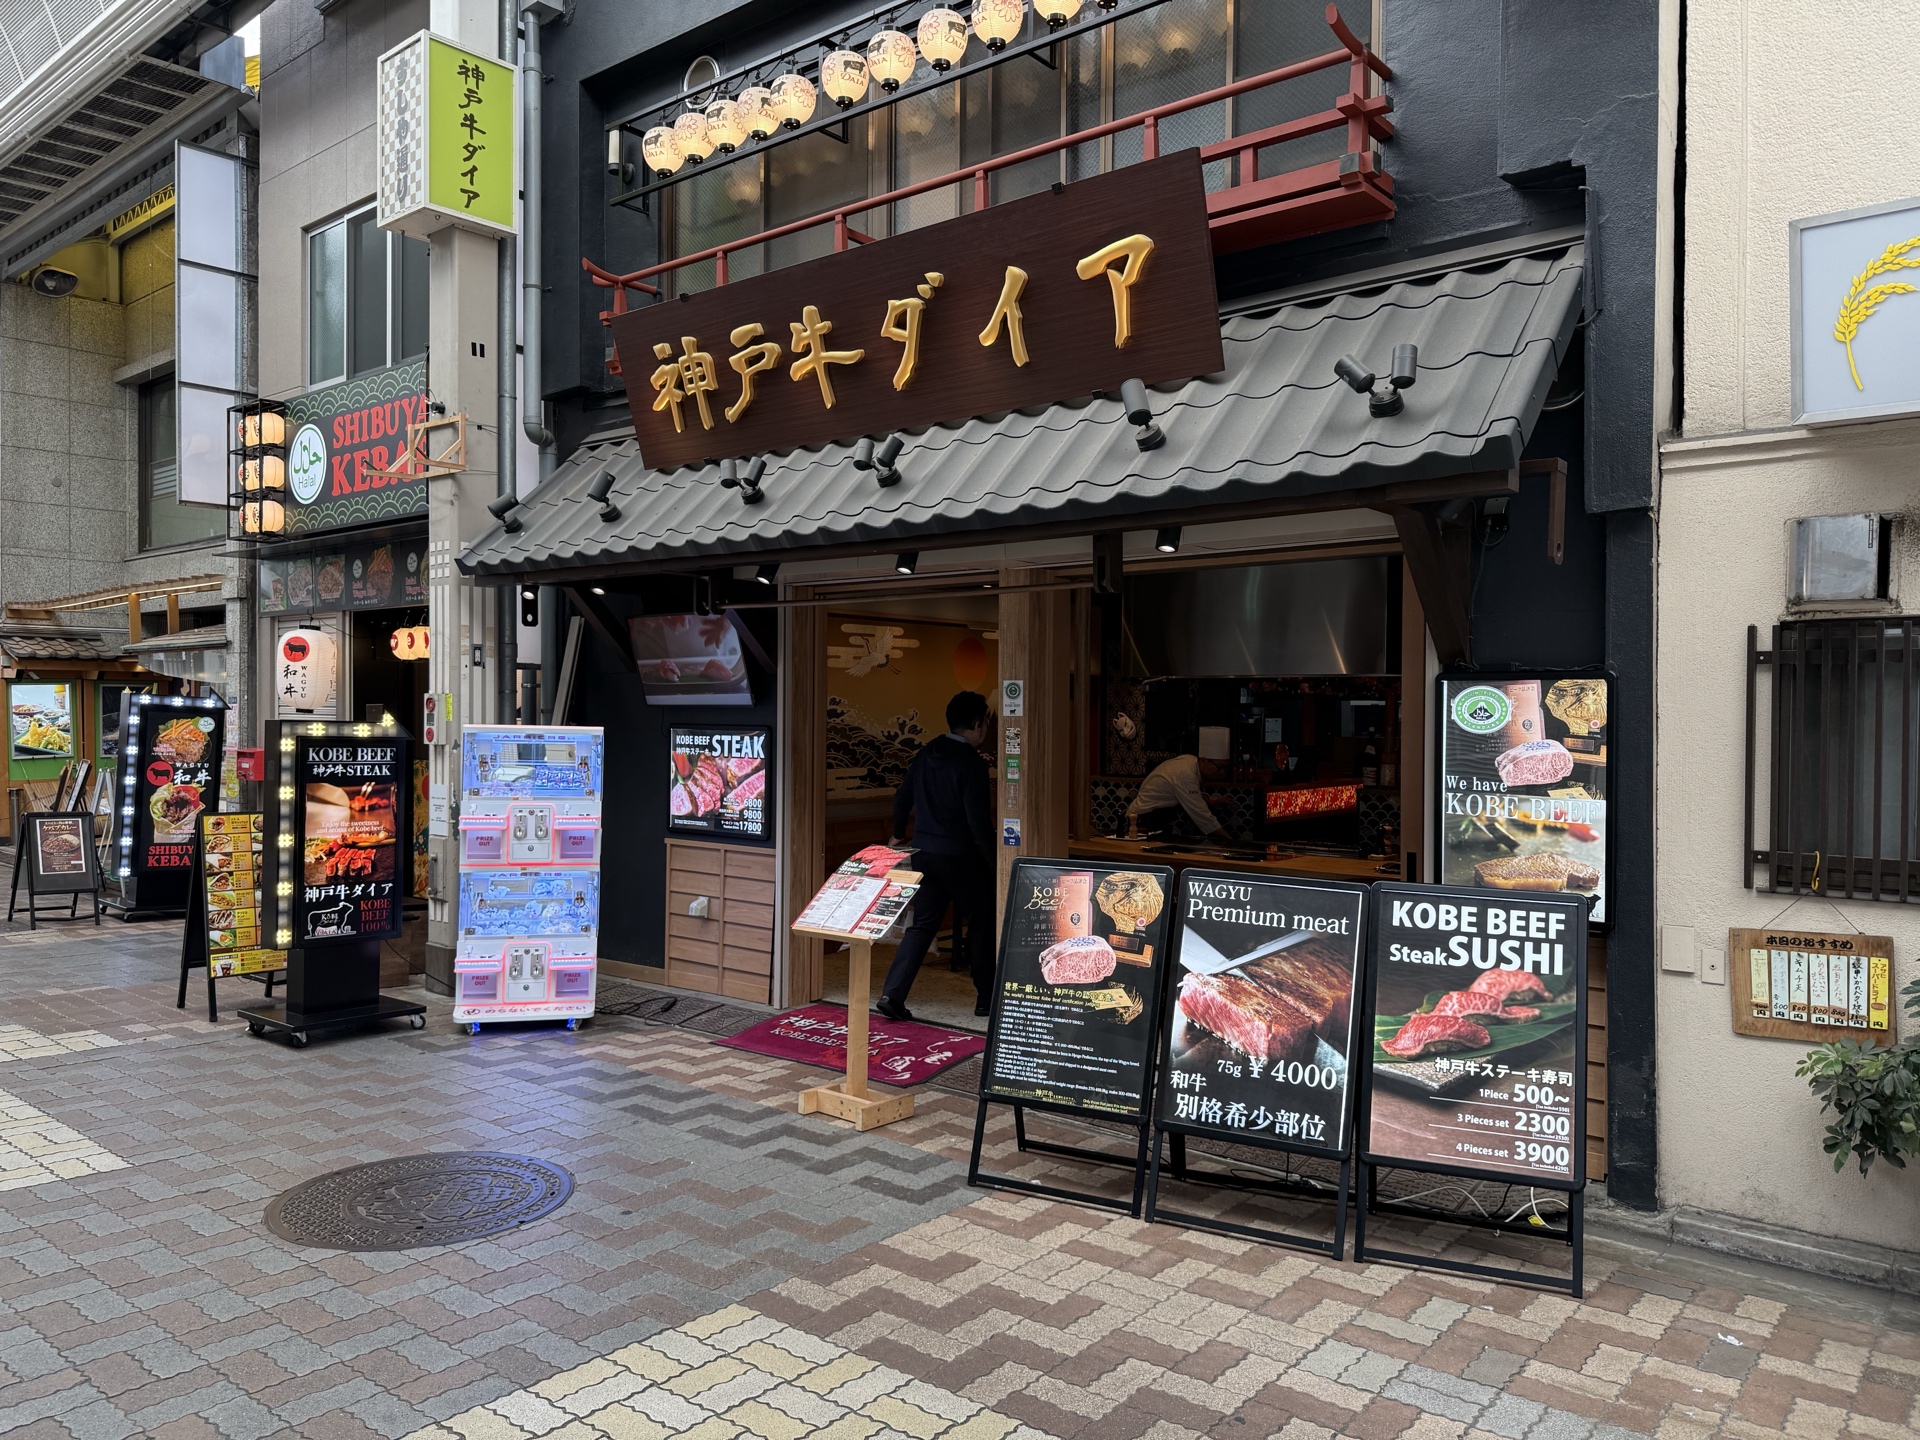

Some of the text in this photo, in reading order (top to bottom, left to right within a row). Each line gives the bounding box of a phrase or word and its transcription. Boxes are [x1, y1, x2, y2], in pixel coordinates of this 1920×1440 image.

[840, 72, 864, 87] DAIA
[457, 59, 486, 208] 神戸牛ダイア
[650, 233, 1155, 434] 神戸牛ダイア
[331, 437, 427, 496] KEBA
[298, 475, 316, 490] Halal
[284, 664, 298, 698] 和牛
[1464, 721, 1499, 729] STANDARD
[308, 747, 396, 761] KOBE BEEF
[676, 734, 766, 758] KOBE BEEF STEAK
[173, 769, 212, 786] 和牛
[313, 764, 391, 777] 神戸牛 STEAK
[1446, 775, 1508, 793] We have
[744, 799, 762, 807] 6800
[1446, 792, 1600, 825] KOBE BEEF
[743, 810, 762, 819] 9800
[740, 821, 762, 831] 17800
[149, 845, 194, 855] SHIBUY
[147, 855, 191, 867] KEBA
[304, 883, 393, 903] 神戸牛ダイア
[1033, 886, 1069, 898] KOBE
[1188, 882, 1252, 901] WAGYU
[360, 899, 391, 910] KOBE
[1024, 893, 1072, 910] Beef
[361, 910, 389, 921] BEEF
[1187, 899, 1349, 935] Premium meat
[1392, 900, 1566, 939] KOBE BEEF
[361, 921, 390, 933] 100%
[1766, 935, 1853, 949] 本日のおすすめ
[1389, 935, 1564, 975] Steak SUSHI
[1794, 958, 1804, 992] キムチ天
[770, 1028, 810, 1040] KOBE
[808, 1034, 842, 1047] BEEF
[1217, 1056, 1337, 1090] 75g ¥ 4000
[1434, 1057, 1572, 1086] 神戸牛ステーキ寿司
[1170, 1070, 1207, 1092] 和牛
[1479, 1088, 1509, 1100] 1Piece
[1174, 1093, 1326, 1141] 別格希少部位
[1457, 1112, 1570, 1135] 3 Pieces set 2300
[1456, 1141, 1569, 1165] 4 Pieces set 3900
